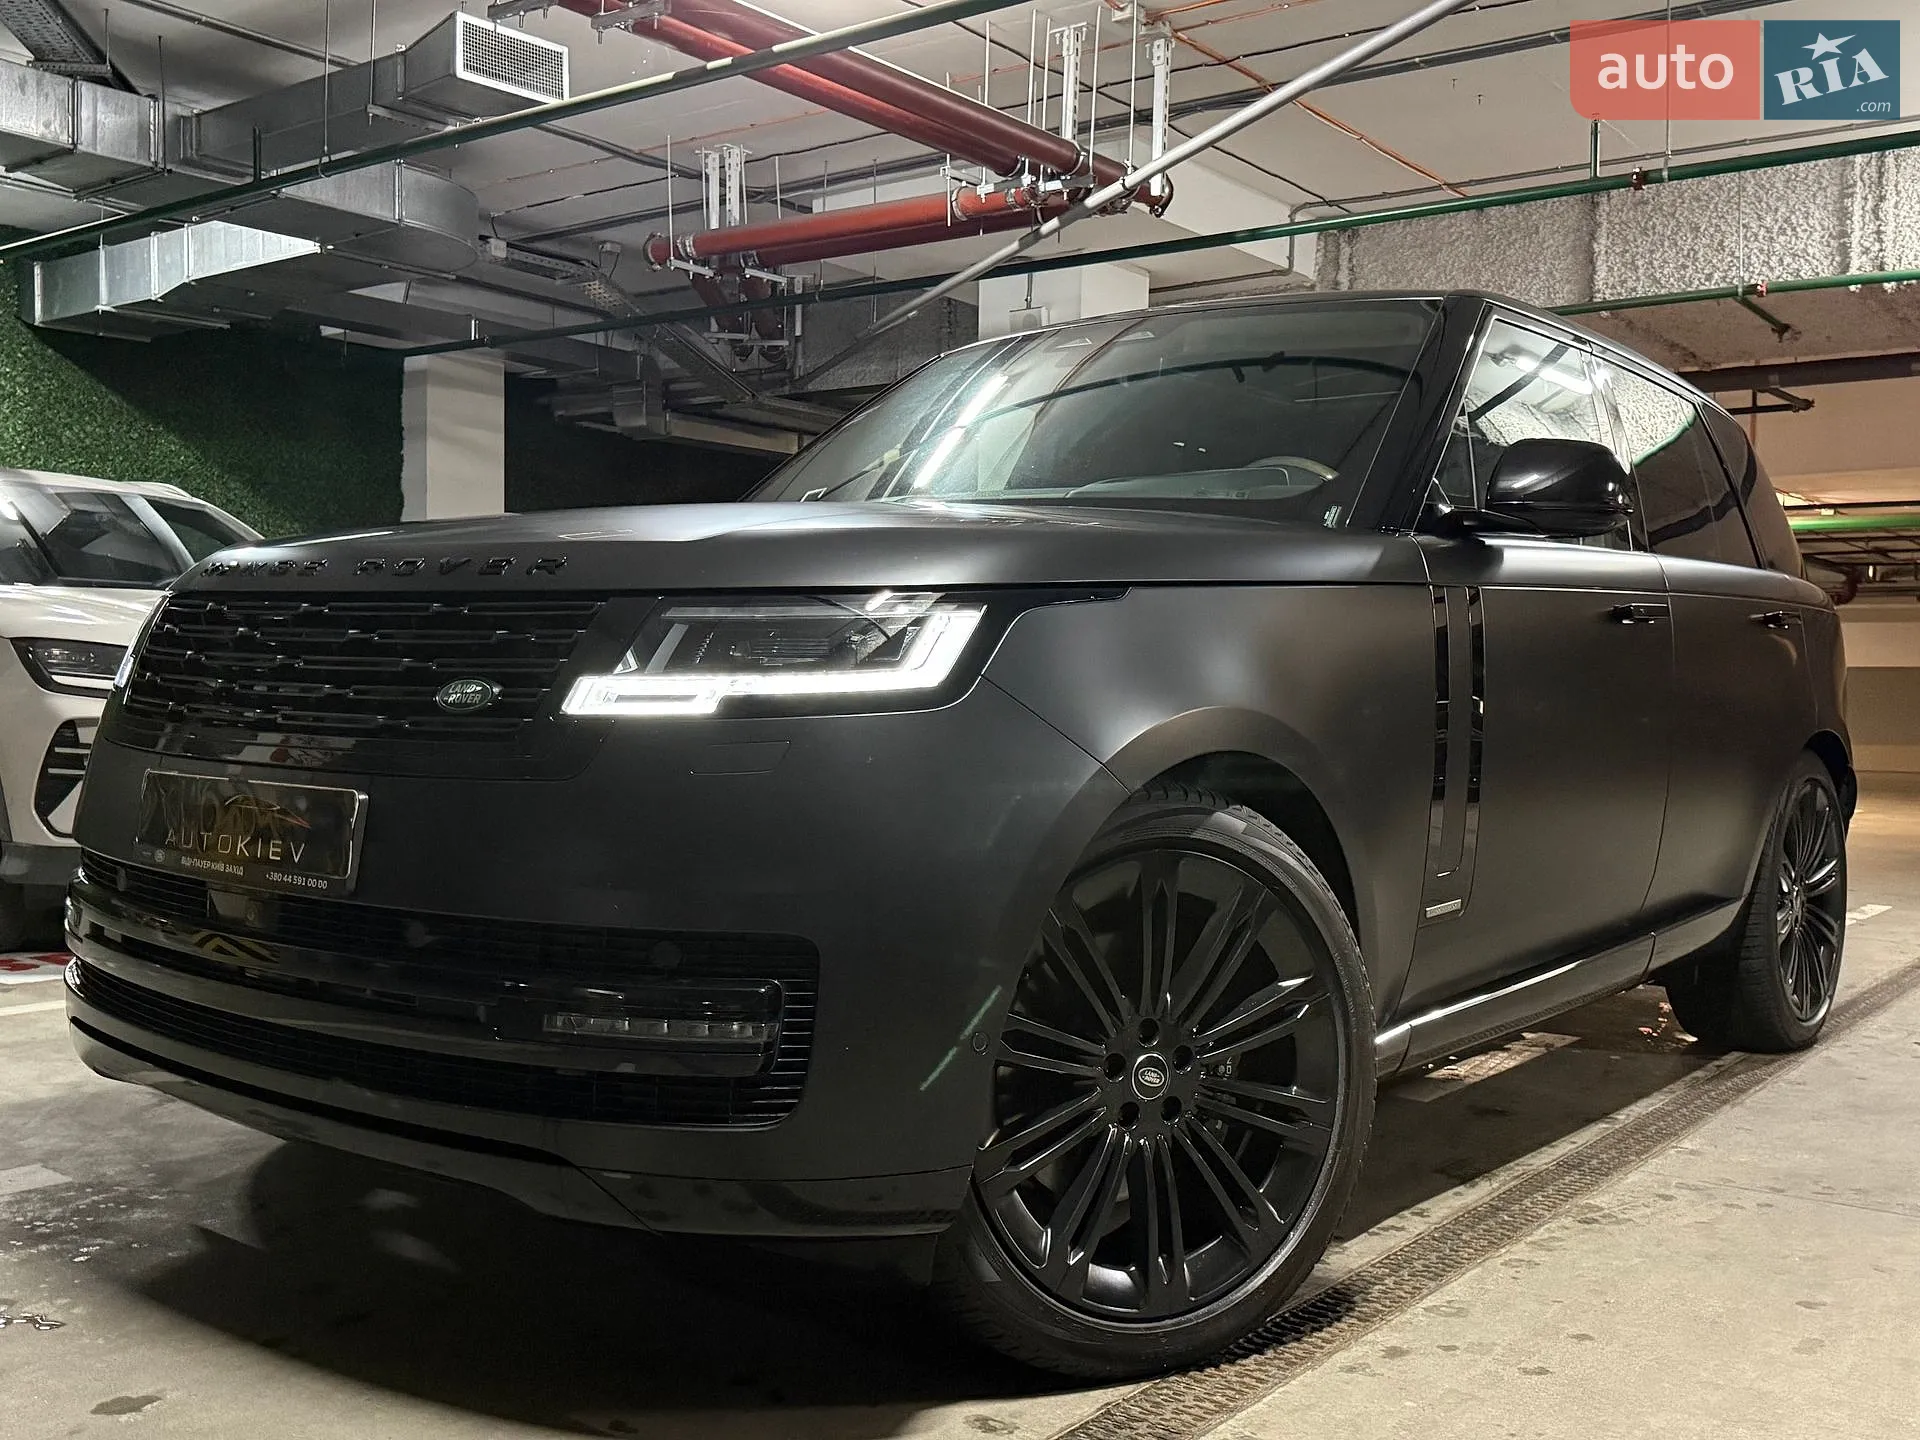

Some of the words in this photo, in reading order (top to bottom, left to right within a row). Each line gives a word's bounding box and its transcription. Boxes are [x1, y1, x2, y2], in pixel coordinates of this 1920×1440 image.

[352, 556, 568, 577] ROVER
[265, 871, 283, 882] +380
[282, 874, 293, 884] 44
[292, 875, 306, 886] 591
[306, 878, 318, 888] 00
[317, 880, 328, 890] 00
